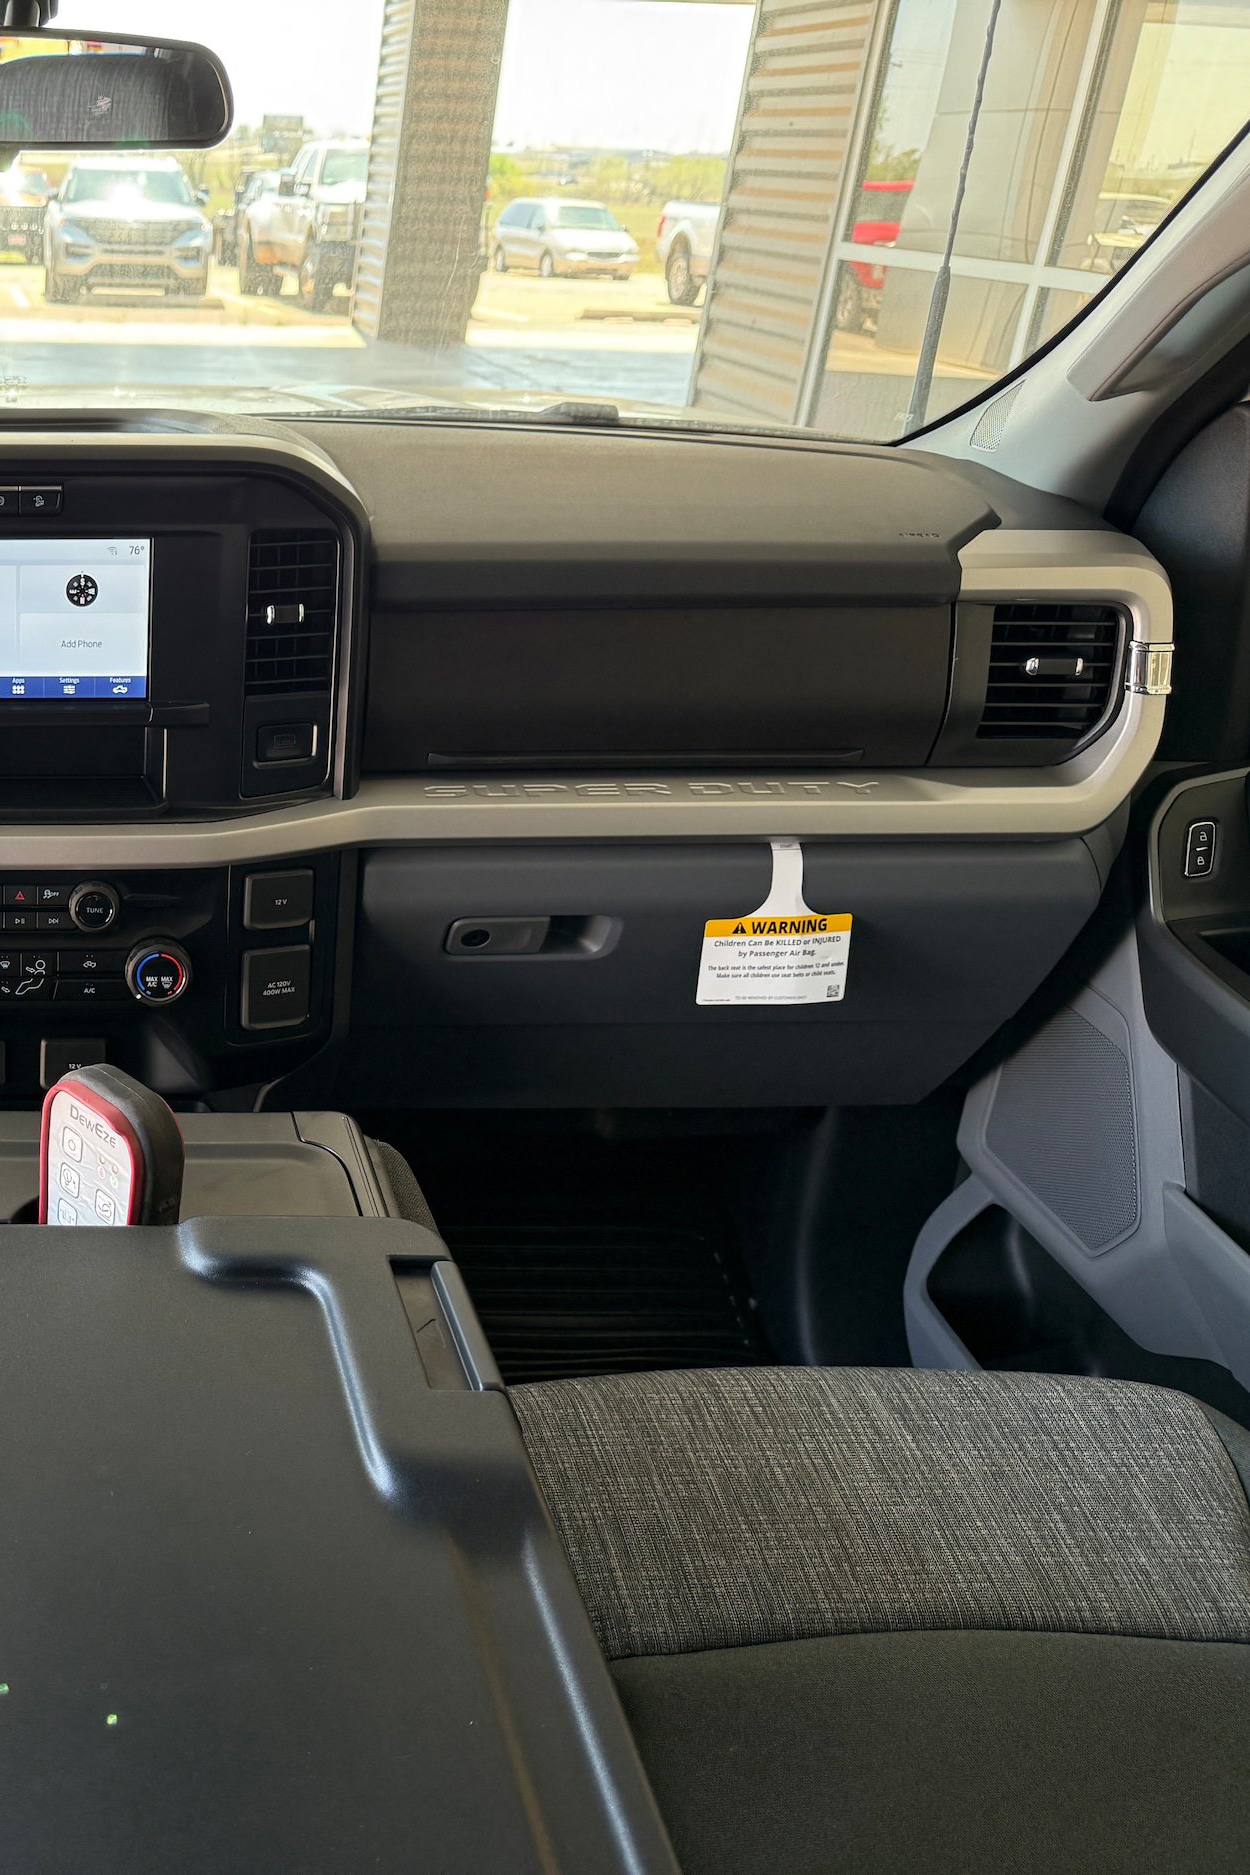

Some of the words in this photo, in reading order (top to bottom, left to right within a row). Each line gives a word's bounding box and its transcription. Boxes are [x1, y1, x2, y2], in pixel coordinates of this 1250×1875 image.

[129, 546, 144, 555] 76°
[61, 640, 77, 648] Add
[78, 639, 102, 648] Phone
[12, 677, 25, 685] Apps
[59, 677, 80, 685] Settings
[424, 783, 672, 798] SUPER
[687, 781, 879, 795] DUTY
[752, 918, 827, 934] WARNING
[812, 936, 841, 944] INJURED
[749, 950, 787, 958] Passenger
[277, 980, 291, 988] 120V
[262, 988, 281, 996] 400W
[281, 986, 295, 994] MAX
